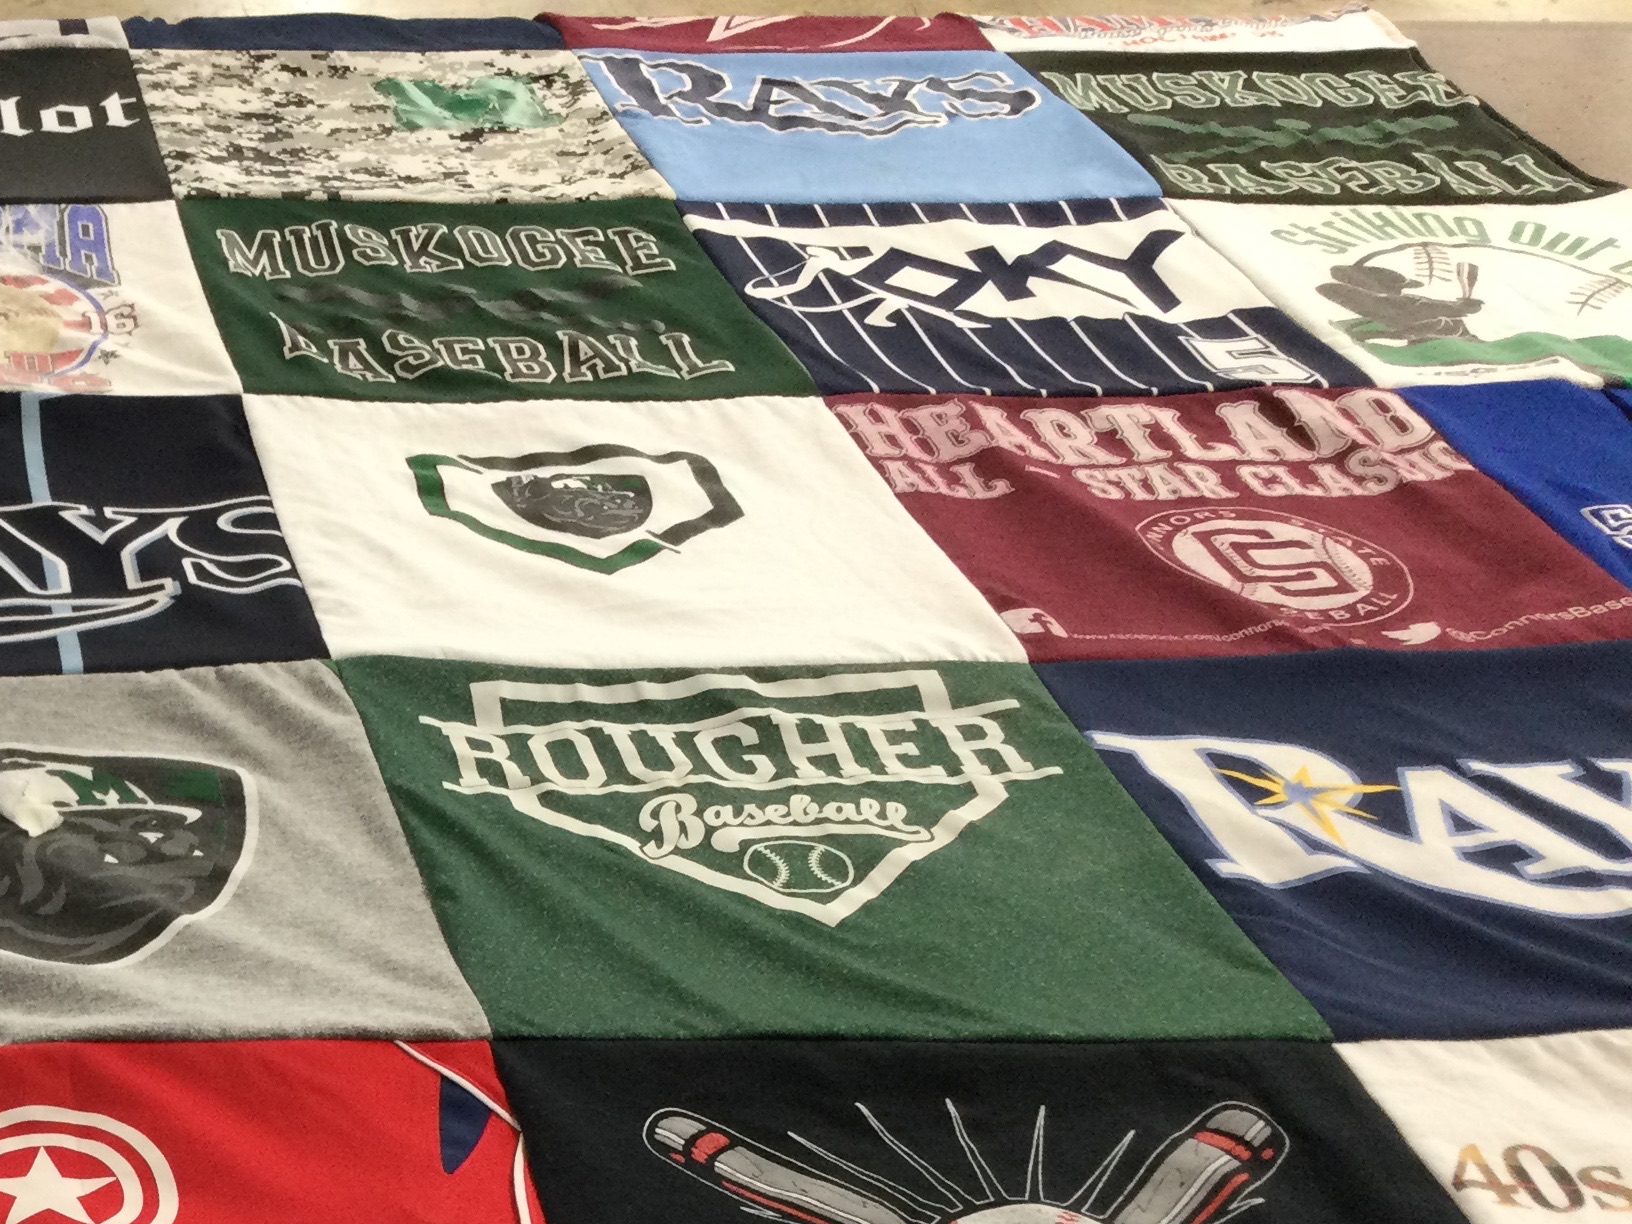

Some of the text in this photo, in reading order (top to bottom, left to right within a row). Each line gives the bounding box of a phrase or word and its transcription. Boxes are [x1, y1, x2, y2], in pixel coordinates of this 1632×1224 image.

[577, 53, 1042, 138] RAYS
[1041, 71, 1480, 113] MUSKOGEE
[1151, 152, 1594, 196] BASEBALL
[216, 220, 676, 281] MUSKOGEE
[1178, 335, 1320, 385] 5
[832, 388, 1438, 467] HEARTLAND
[878, 459, 1015, 500] ALL
[1072, 461, 1241, 500] STAR
[442, 710, 1036, 789] ROUGHER
[638, 792, 932, 858] Baseball
